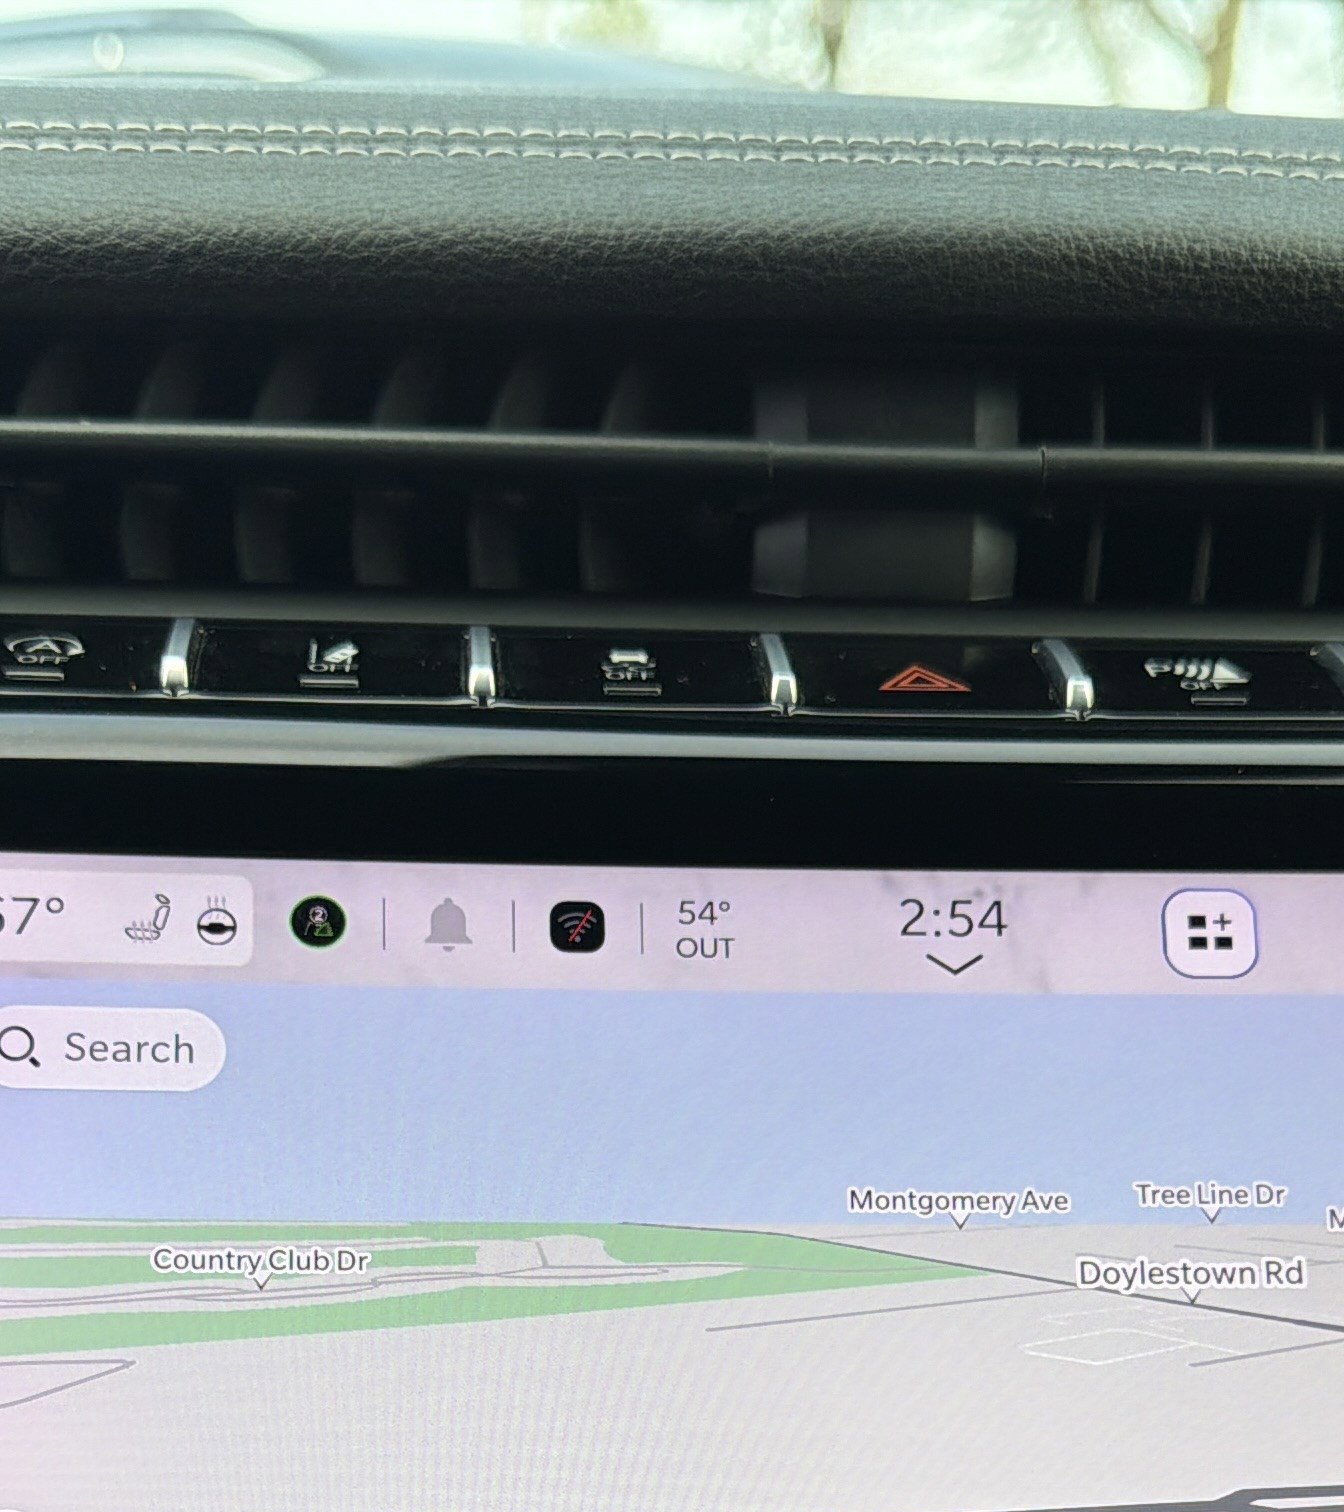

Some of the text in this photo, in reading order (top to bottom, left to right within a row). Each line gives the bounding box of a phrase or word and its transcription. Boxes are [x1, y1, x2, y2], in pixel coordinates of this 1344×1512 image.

[677, 900, 731, 926] 54°
[898, 897, 1009, 939] 2:54
[676, 937, 735, 960] OUT
[64, 1032, 196, 1067] Search
[849, 1188, 1069, 1215] Montgomery Ave
[1135, 1181, 1286, 1206] Tree Line Dr
[153, 1247, 370, 1275] Country Club Dr
[1078, 1258, 1306, 1293] Doylestown Rd
